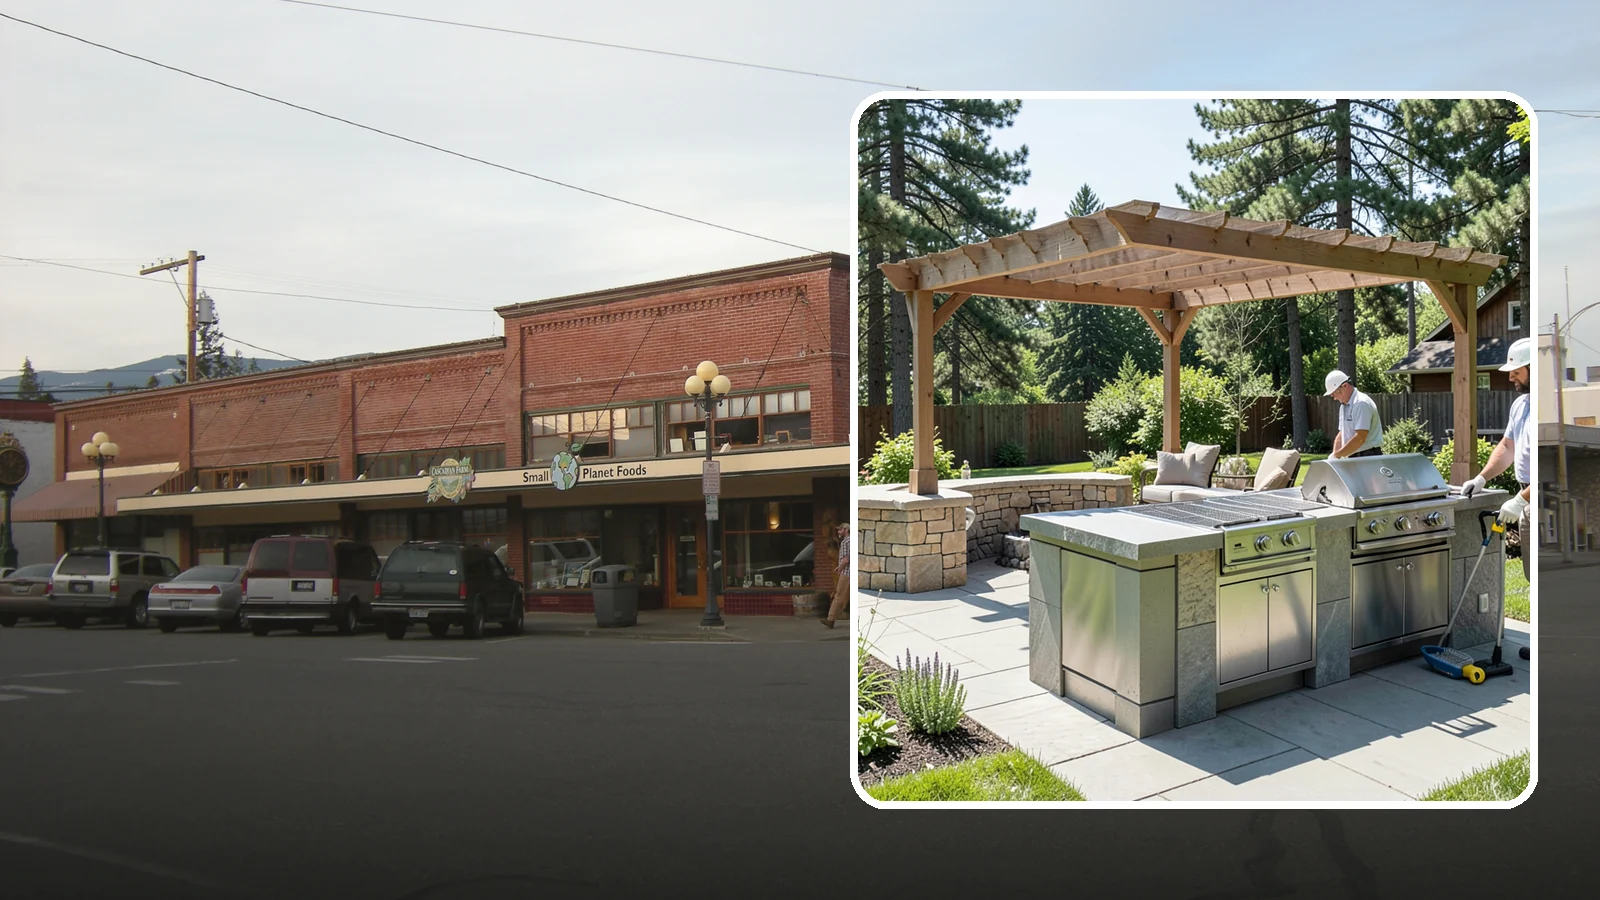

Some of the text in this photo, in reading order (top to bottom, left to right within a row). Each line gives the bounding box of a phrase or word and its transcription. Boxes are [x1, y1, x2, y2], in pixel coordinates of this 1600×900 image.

[523, 464, 647, 482] Small Planet Foods
